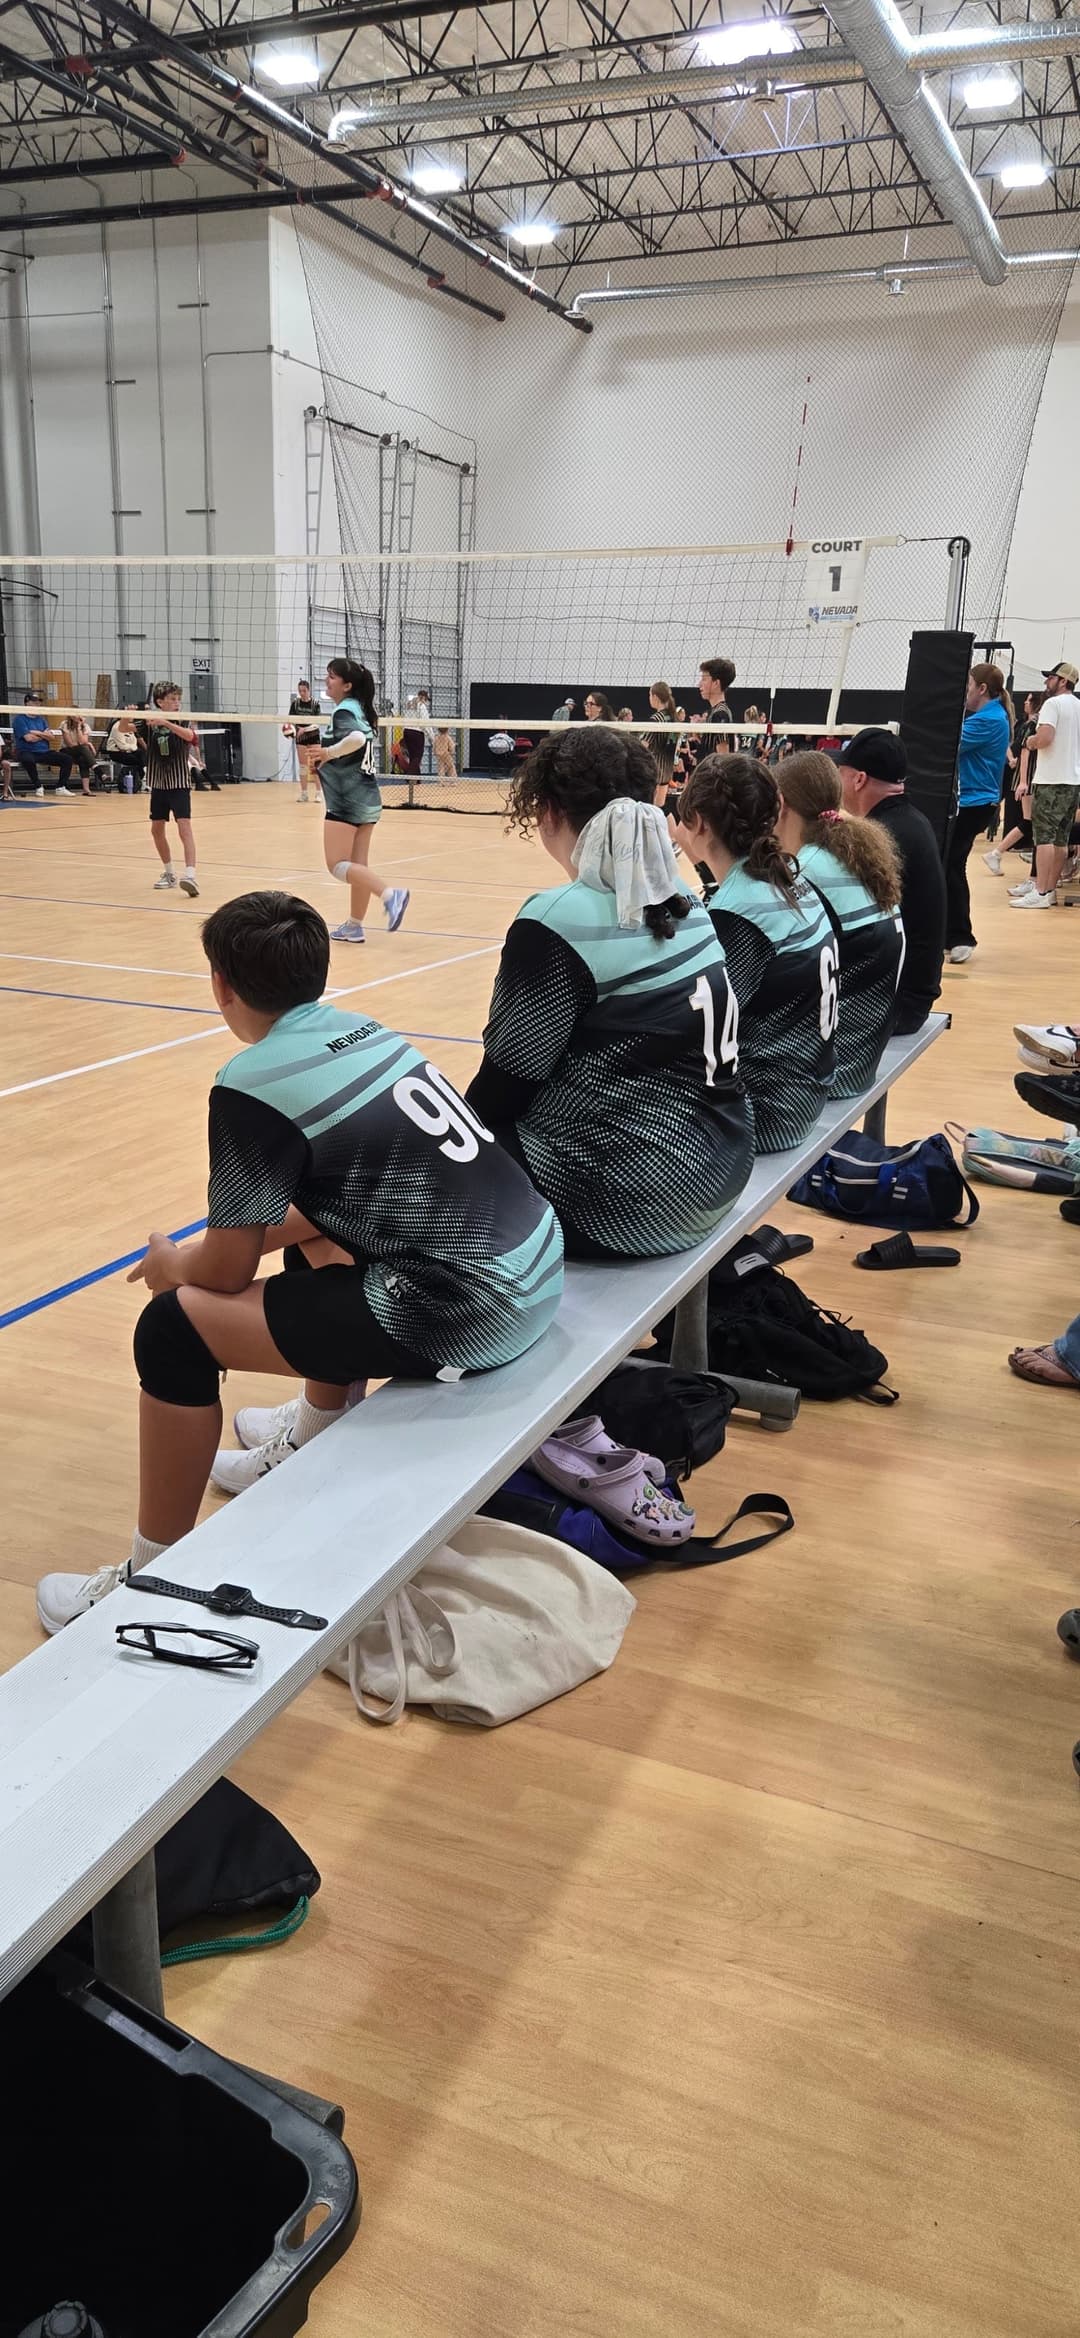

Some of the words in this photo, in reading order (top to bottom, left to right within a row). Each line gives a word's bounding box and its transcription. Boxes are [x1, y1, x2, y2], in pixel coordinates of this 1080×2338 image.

[811, 540, 862, 553] COURT
[829, 566, 842, 592] 1
[821, 605, 858, 615] NEVADA
[192, 658, 211, 668] EXIT
[688, 966, 739, 1086] 14
[325, 1026, 374, 1054] NEVADA
[392, 1062, 495, 1163] 90
